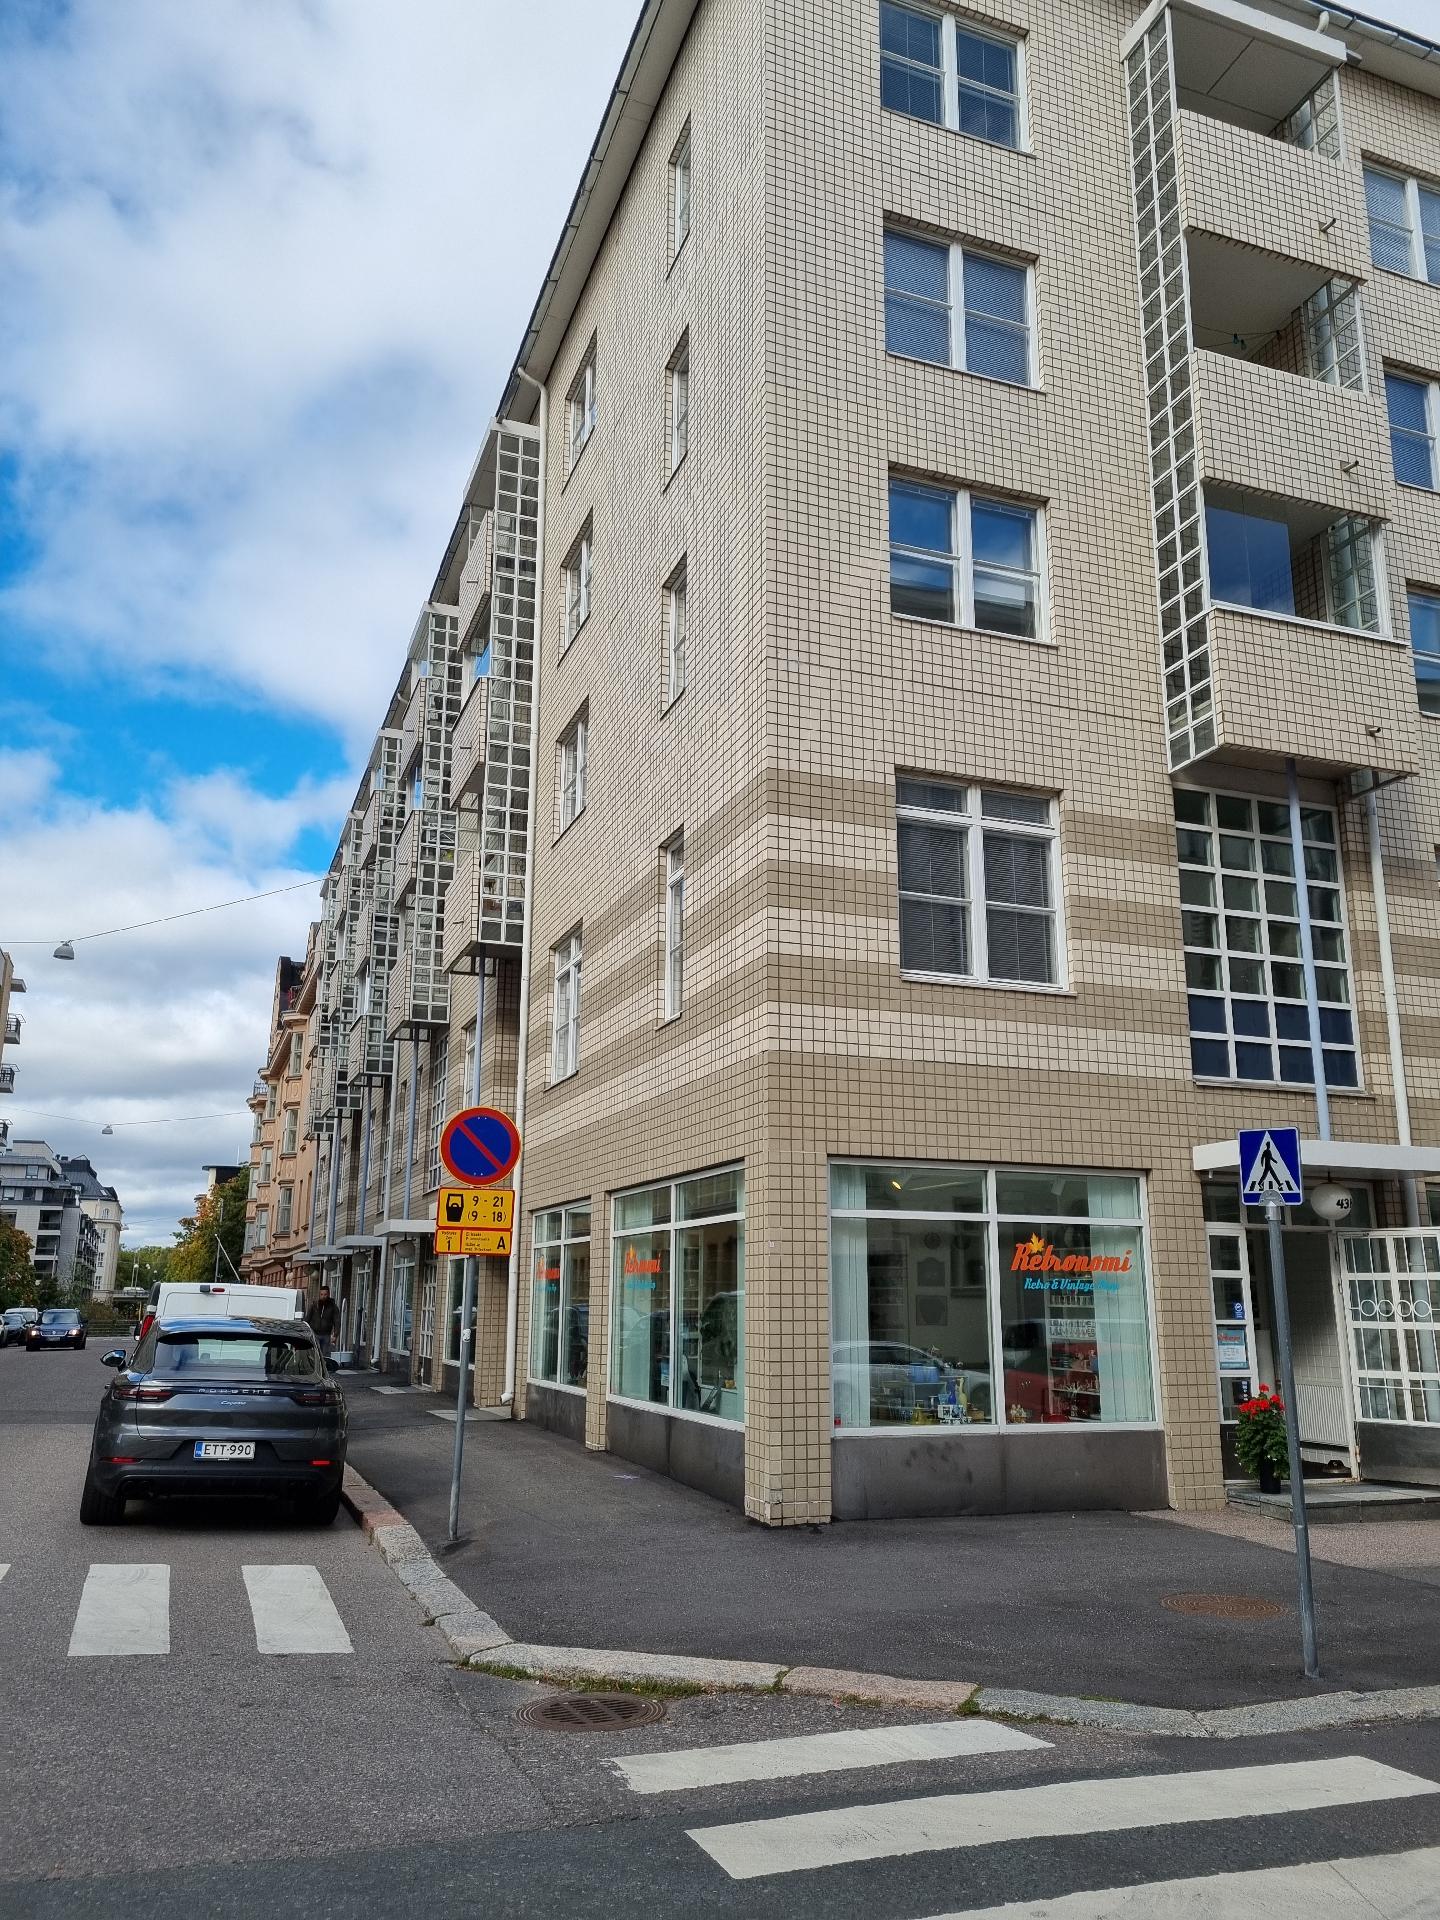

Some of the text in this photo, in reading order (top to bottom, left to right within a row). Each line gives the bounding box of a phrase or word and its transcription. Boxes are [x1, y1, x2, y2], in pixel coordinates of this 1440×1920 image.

[472, 1195, 479, 1207] 9
[493, 1196, 504, 1207] 21
[468, 1210, 478, 1222] (9
[492, 1211, 507, 1223] 18)
[447, 1240, 451, 1251] 1
[496, 1236, 506, 1250] A
[1011, 1243, 1133, 1272] Retronomi
[1024, 1278, 1049, 1290] Retro
[1051, 1278, 1059, 1290] &
[1060, 1278, 1095, 1292] Vintage
[204, 1444, 252, 1456] ETT-990
